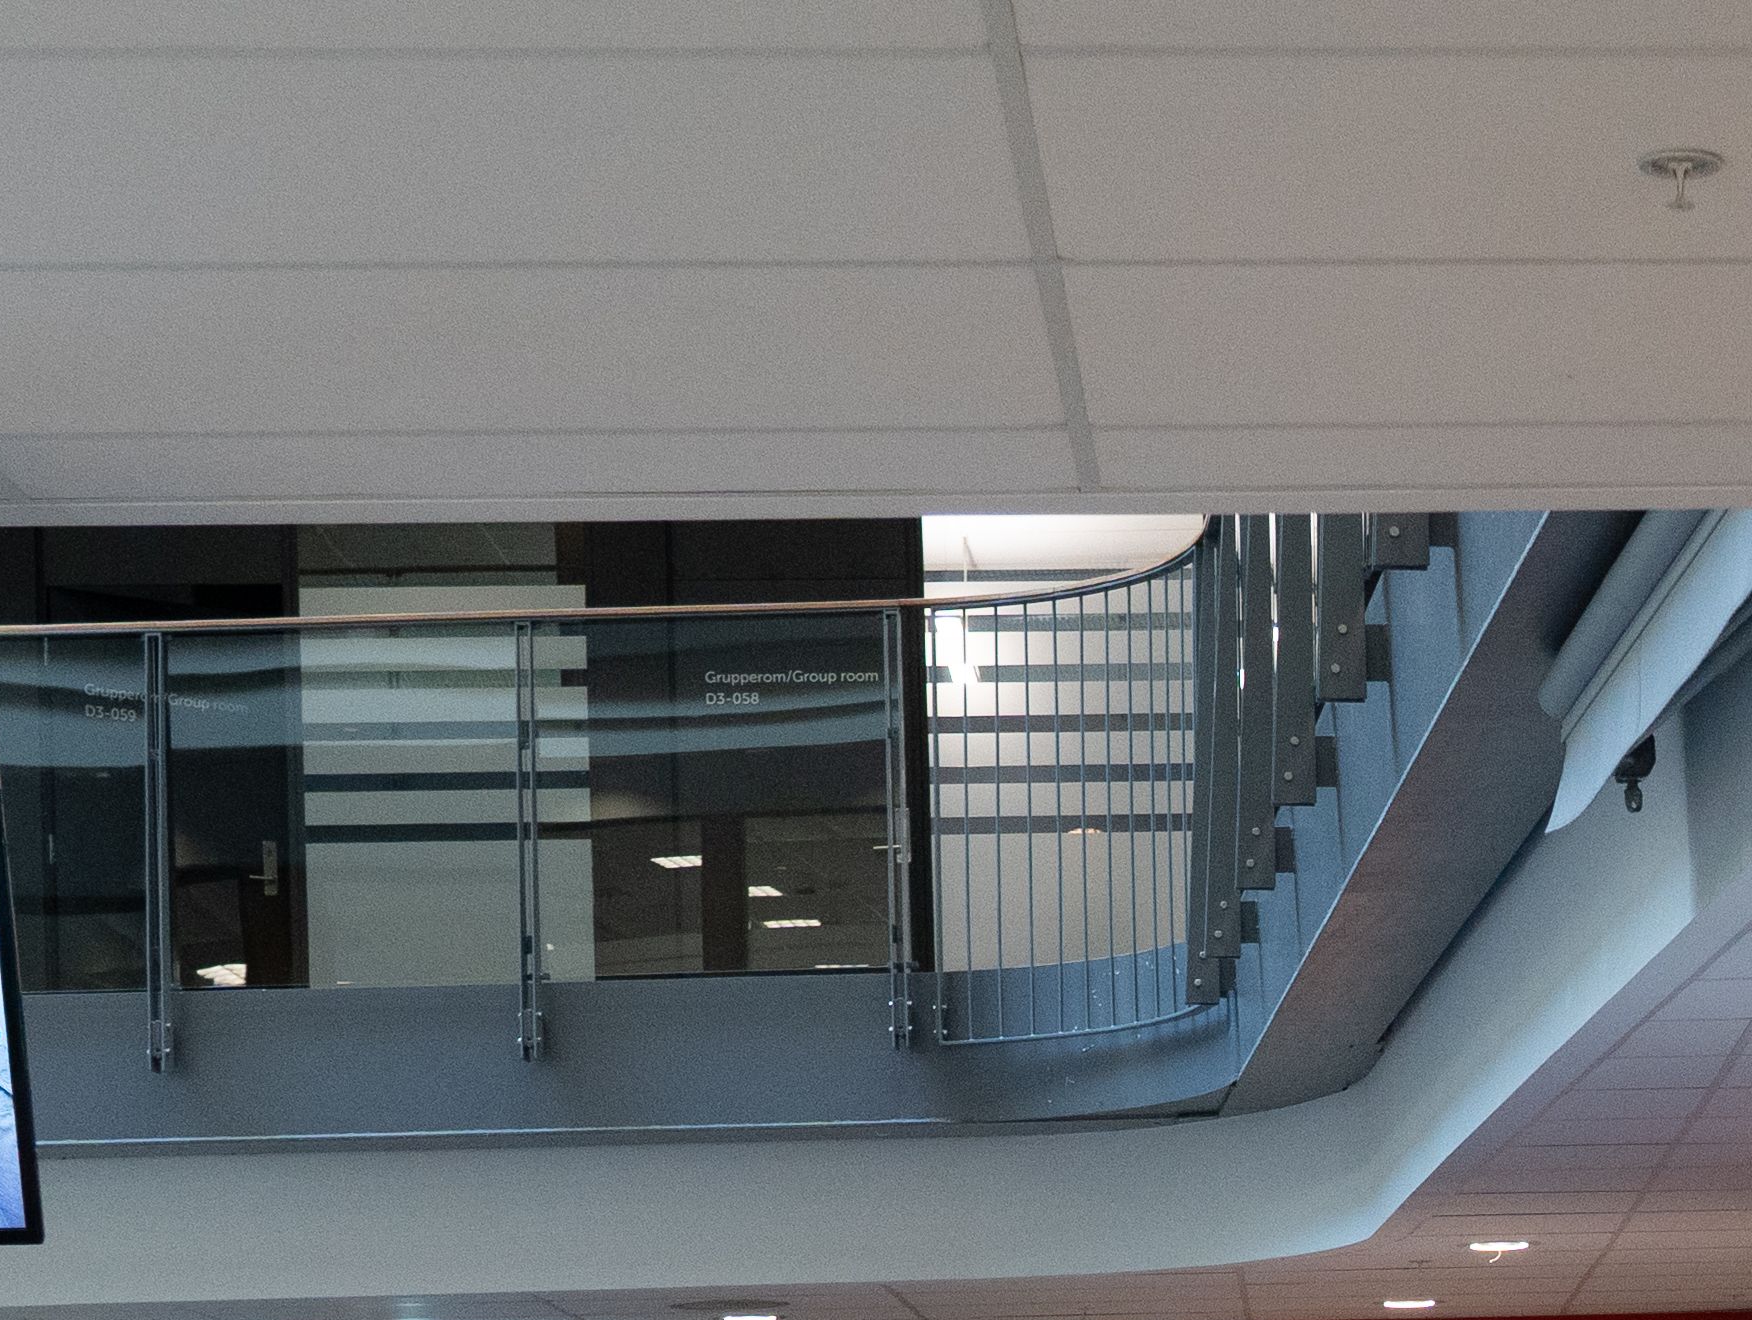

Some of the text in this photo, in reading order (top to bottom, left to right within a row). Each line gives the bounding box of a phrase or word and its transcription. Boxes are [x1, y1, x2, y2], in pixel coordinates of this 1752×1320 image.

[705, 670, 879, 686] Grupperom/Group room
[706, 692, 759, 705] D3-058
[85, 705, 137, 721] D3-059
